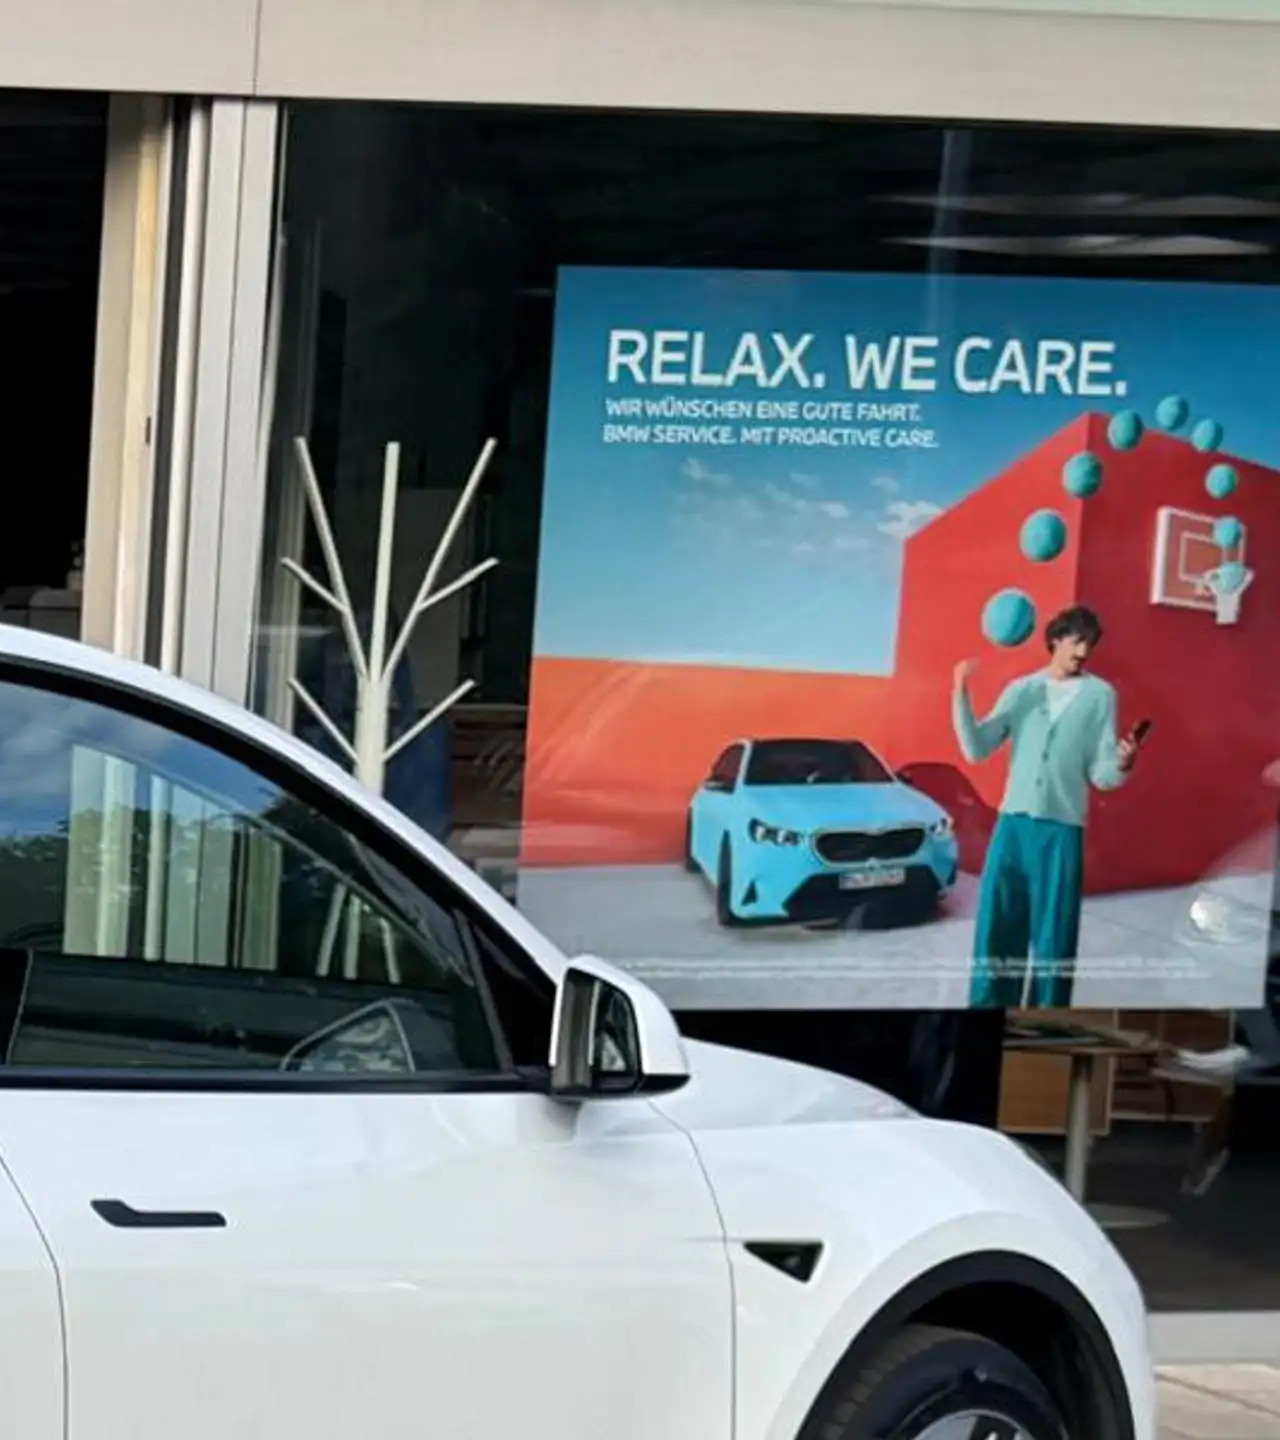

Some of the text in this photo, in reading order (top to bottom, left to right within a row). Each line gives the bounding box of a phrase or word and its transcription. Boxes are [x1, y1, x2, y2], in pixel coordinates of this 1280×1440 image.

[607, 328, 1127, 396] RELAX. WE CARE.
[605, 396, 921, 422] WIR WÜNSCHEN EINE GUTE FAHRT.
[603, 424, 939, 448] BMW SERVICE. MIT PROACTIVE CARE.
